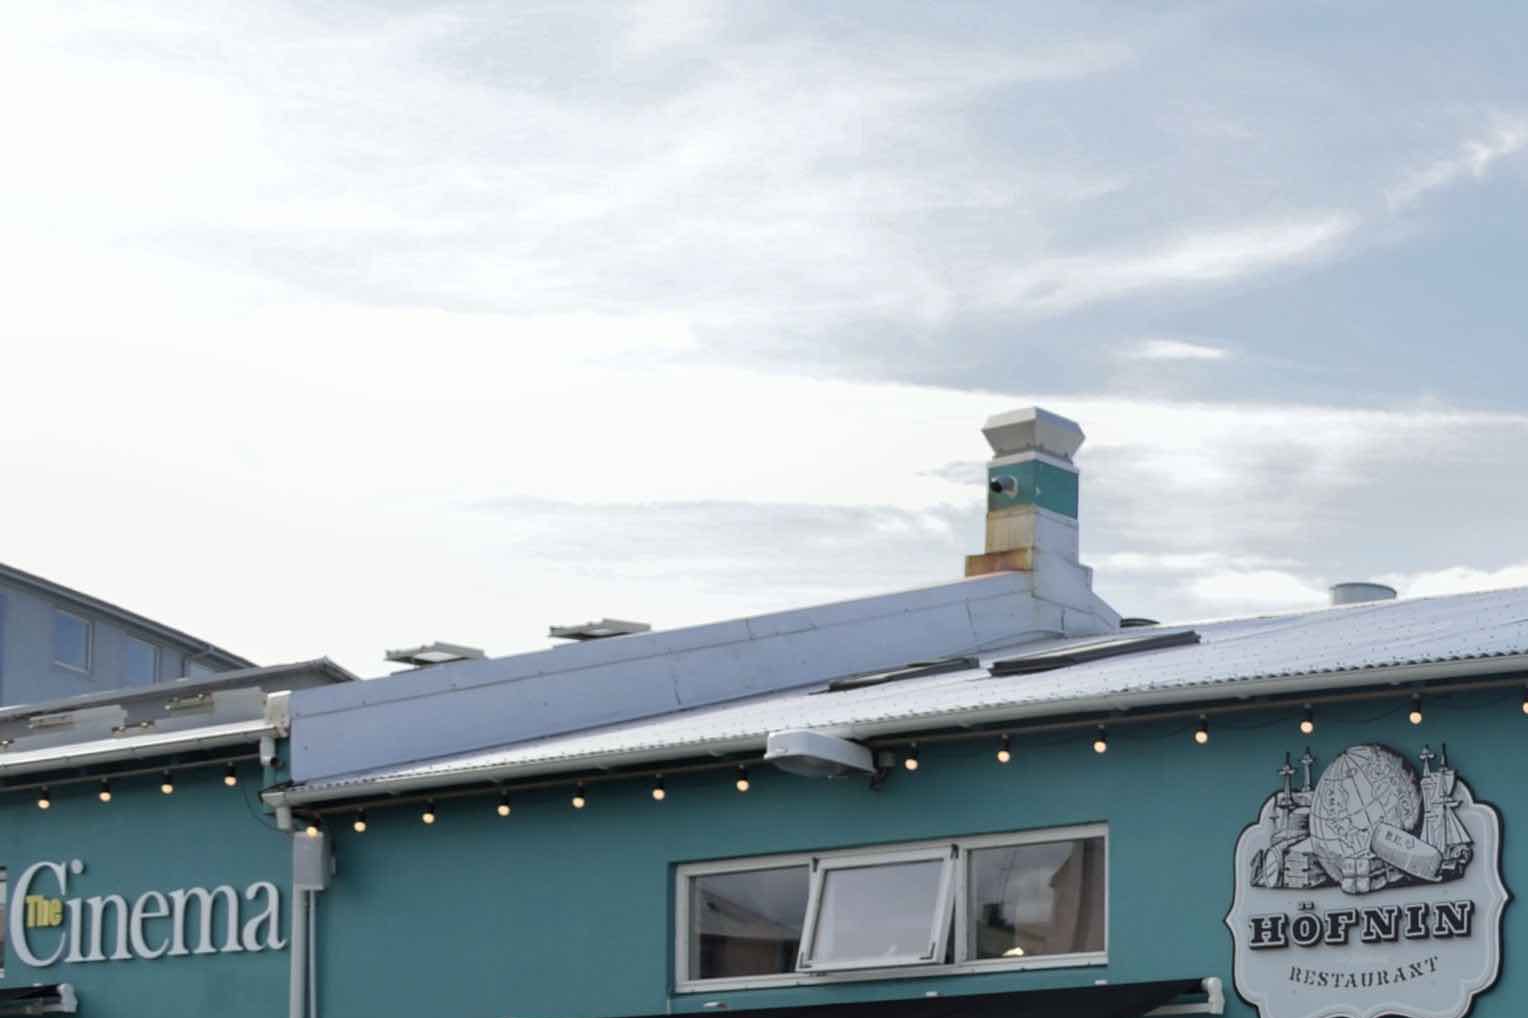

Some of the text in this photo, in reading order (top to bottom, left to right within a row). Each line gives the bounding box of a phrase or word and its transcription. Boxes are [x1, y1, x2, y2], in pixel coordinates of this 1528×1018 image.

[9, 859, 288, 968] The Cinema
[1248, 901, 1475, 949] HÖFNIN
[1289, 956, 1439, 989] RESTAURANT
